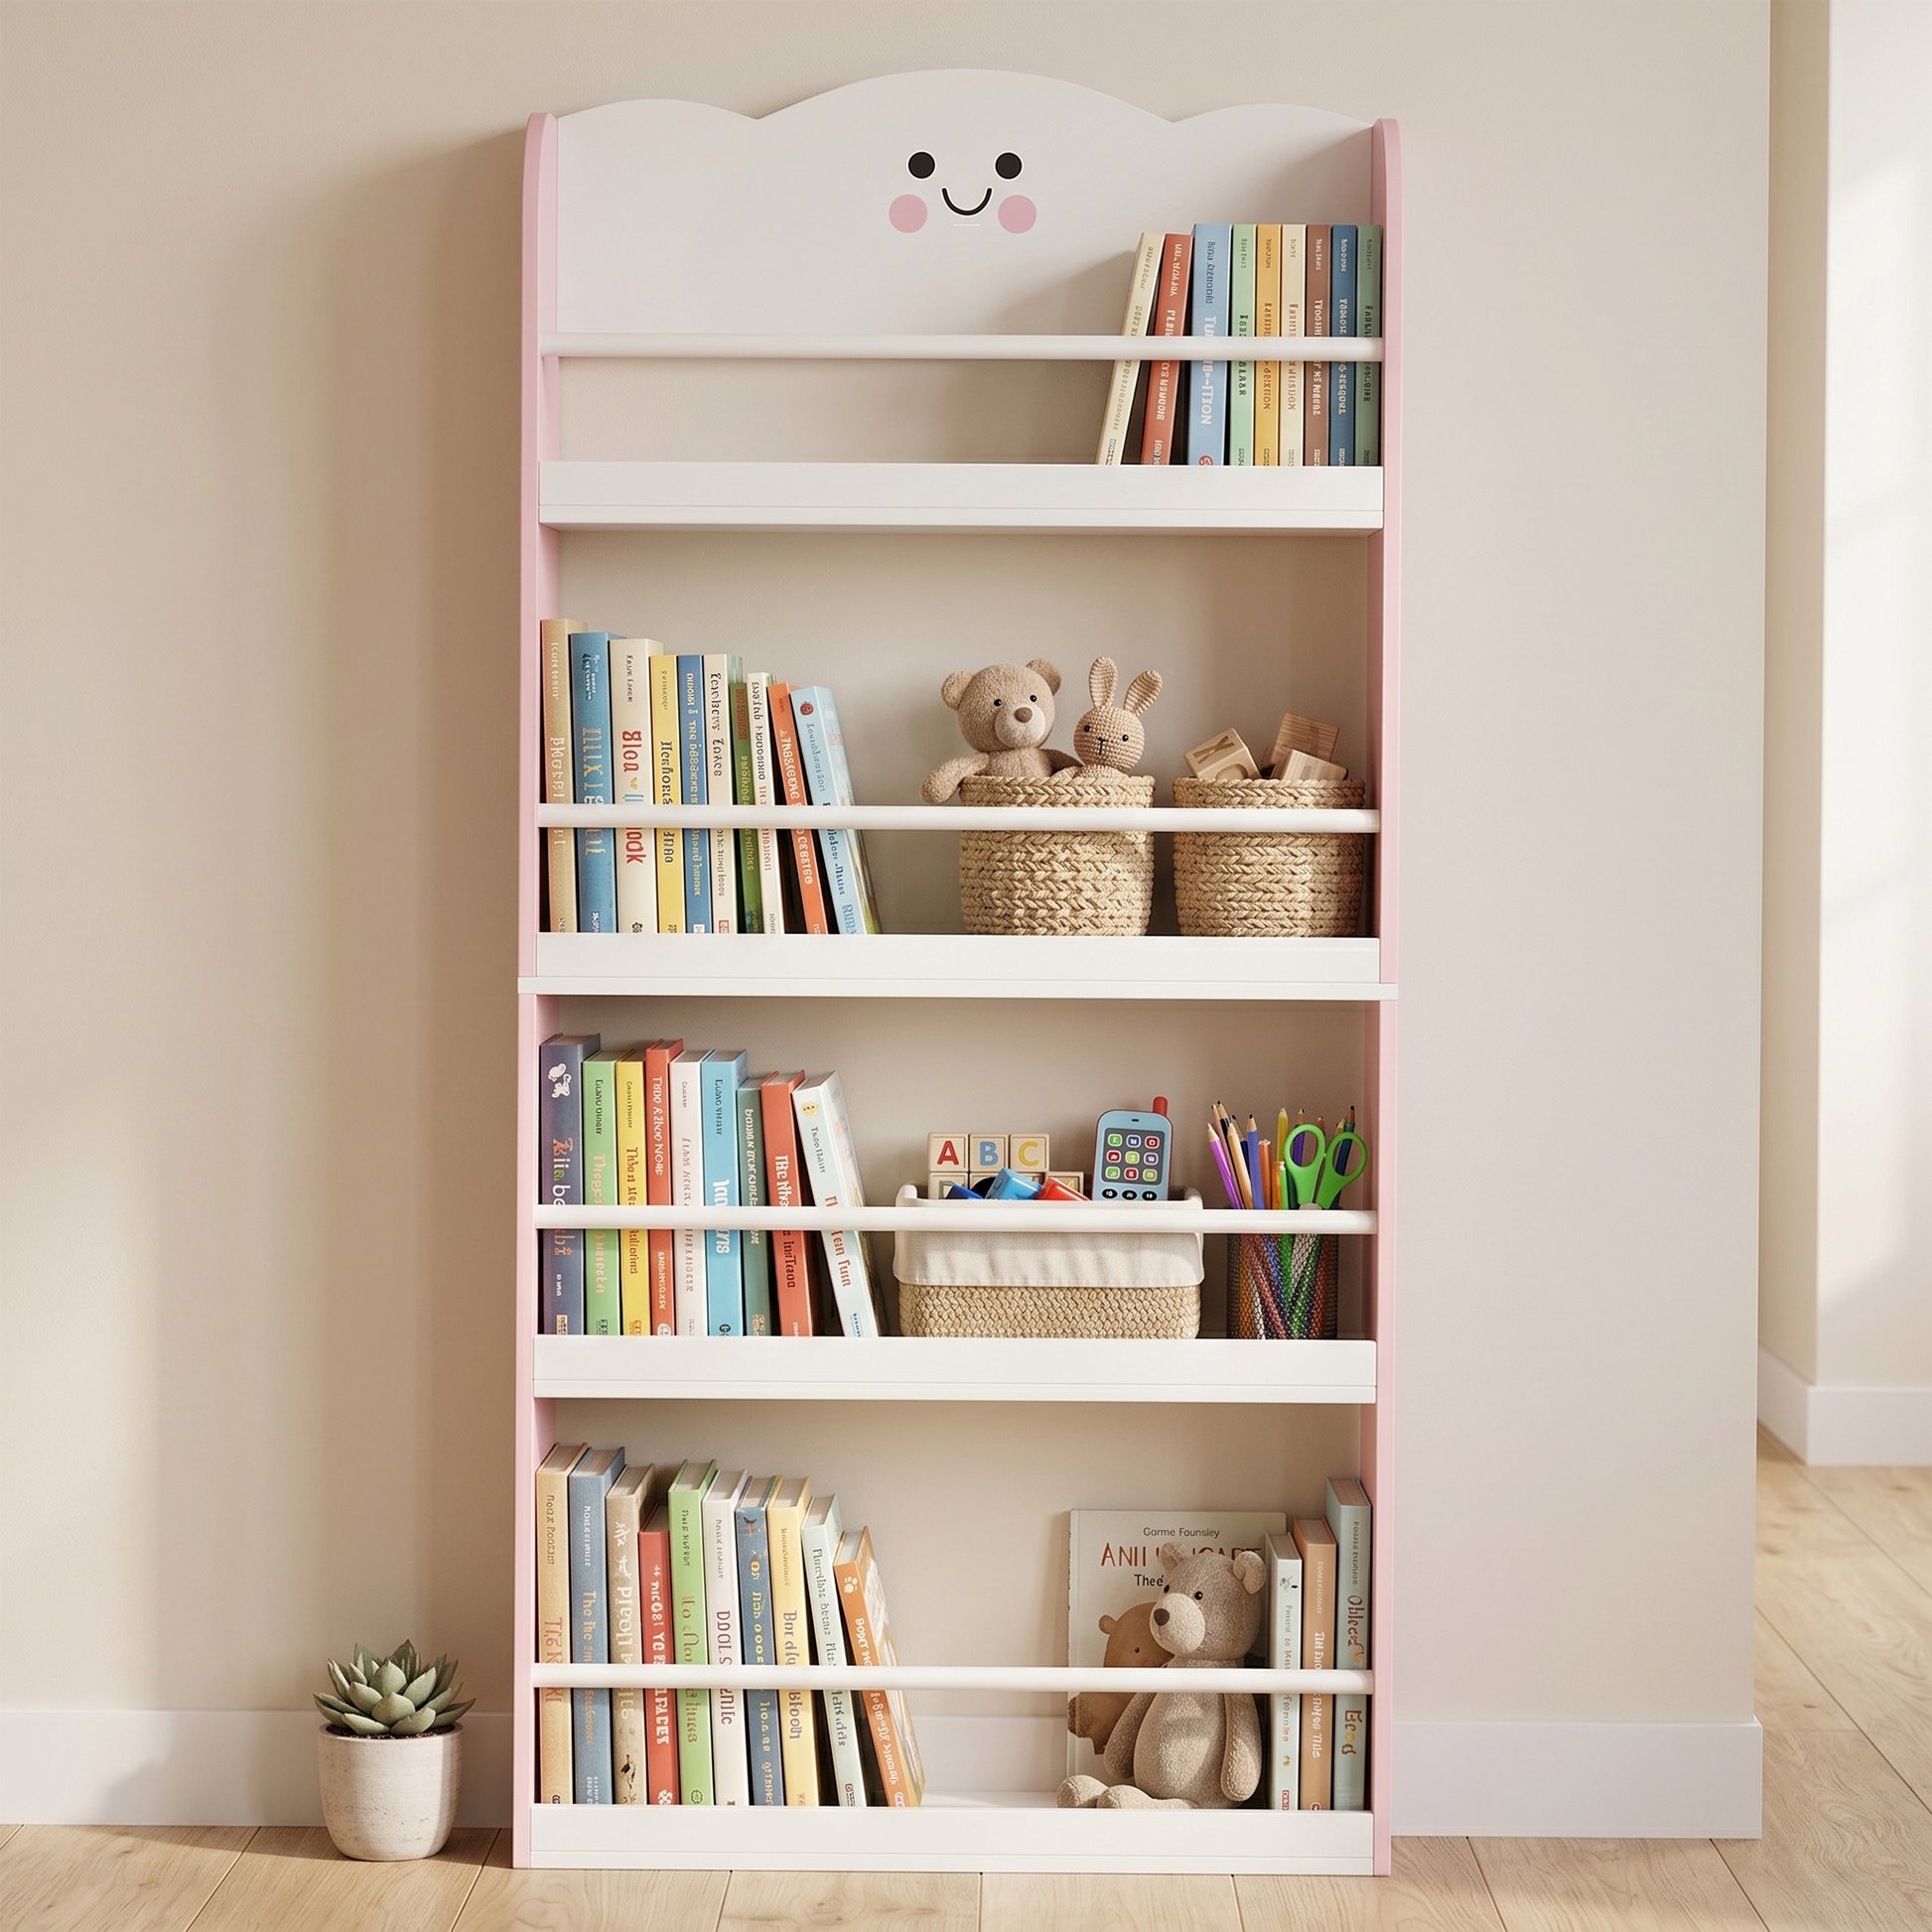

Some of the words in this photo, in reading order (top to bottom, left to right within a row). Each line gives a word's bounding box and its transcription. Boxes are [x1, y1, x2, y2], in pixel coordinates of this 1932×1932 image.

[936, 1140, 960, 1166] A
[979, 1141, 999, 1167] B
[1018, 1141, 1039, 1168] C
[1143, 1527, 1175, 1537] Garme
[1178, 1527, 1220, 1540] Founsley
